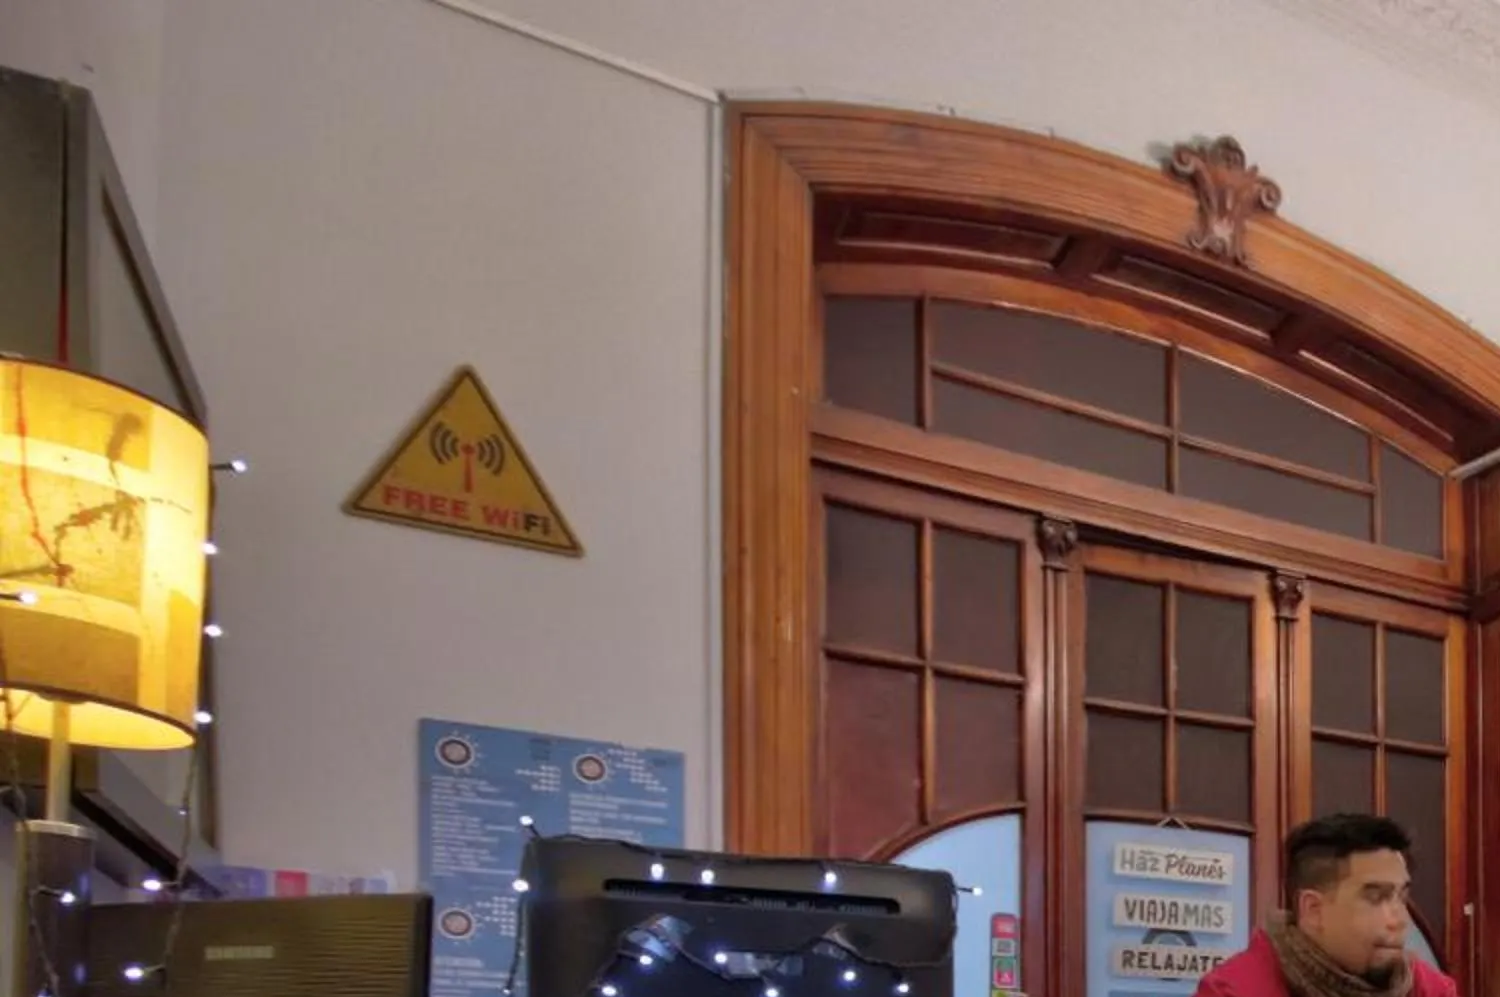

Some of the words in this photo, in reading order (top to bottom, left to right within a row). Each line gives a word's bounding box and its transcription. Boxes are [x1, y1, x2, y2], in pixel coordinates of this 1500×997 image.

[382, 484, 470, 521] FREE
[1120, 847, 1161, 872] Haz
[1163, 852, 1228, 880] Planes
[1123, 896, 1180, 925] VIAJA
[1182, 902, 1225, 928] MAS
